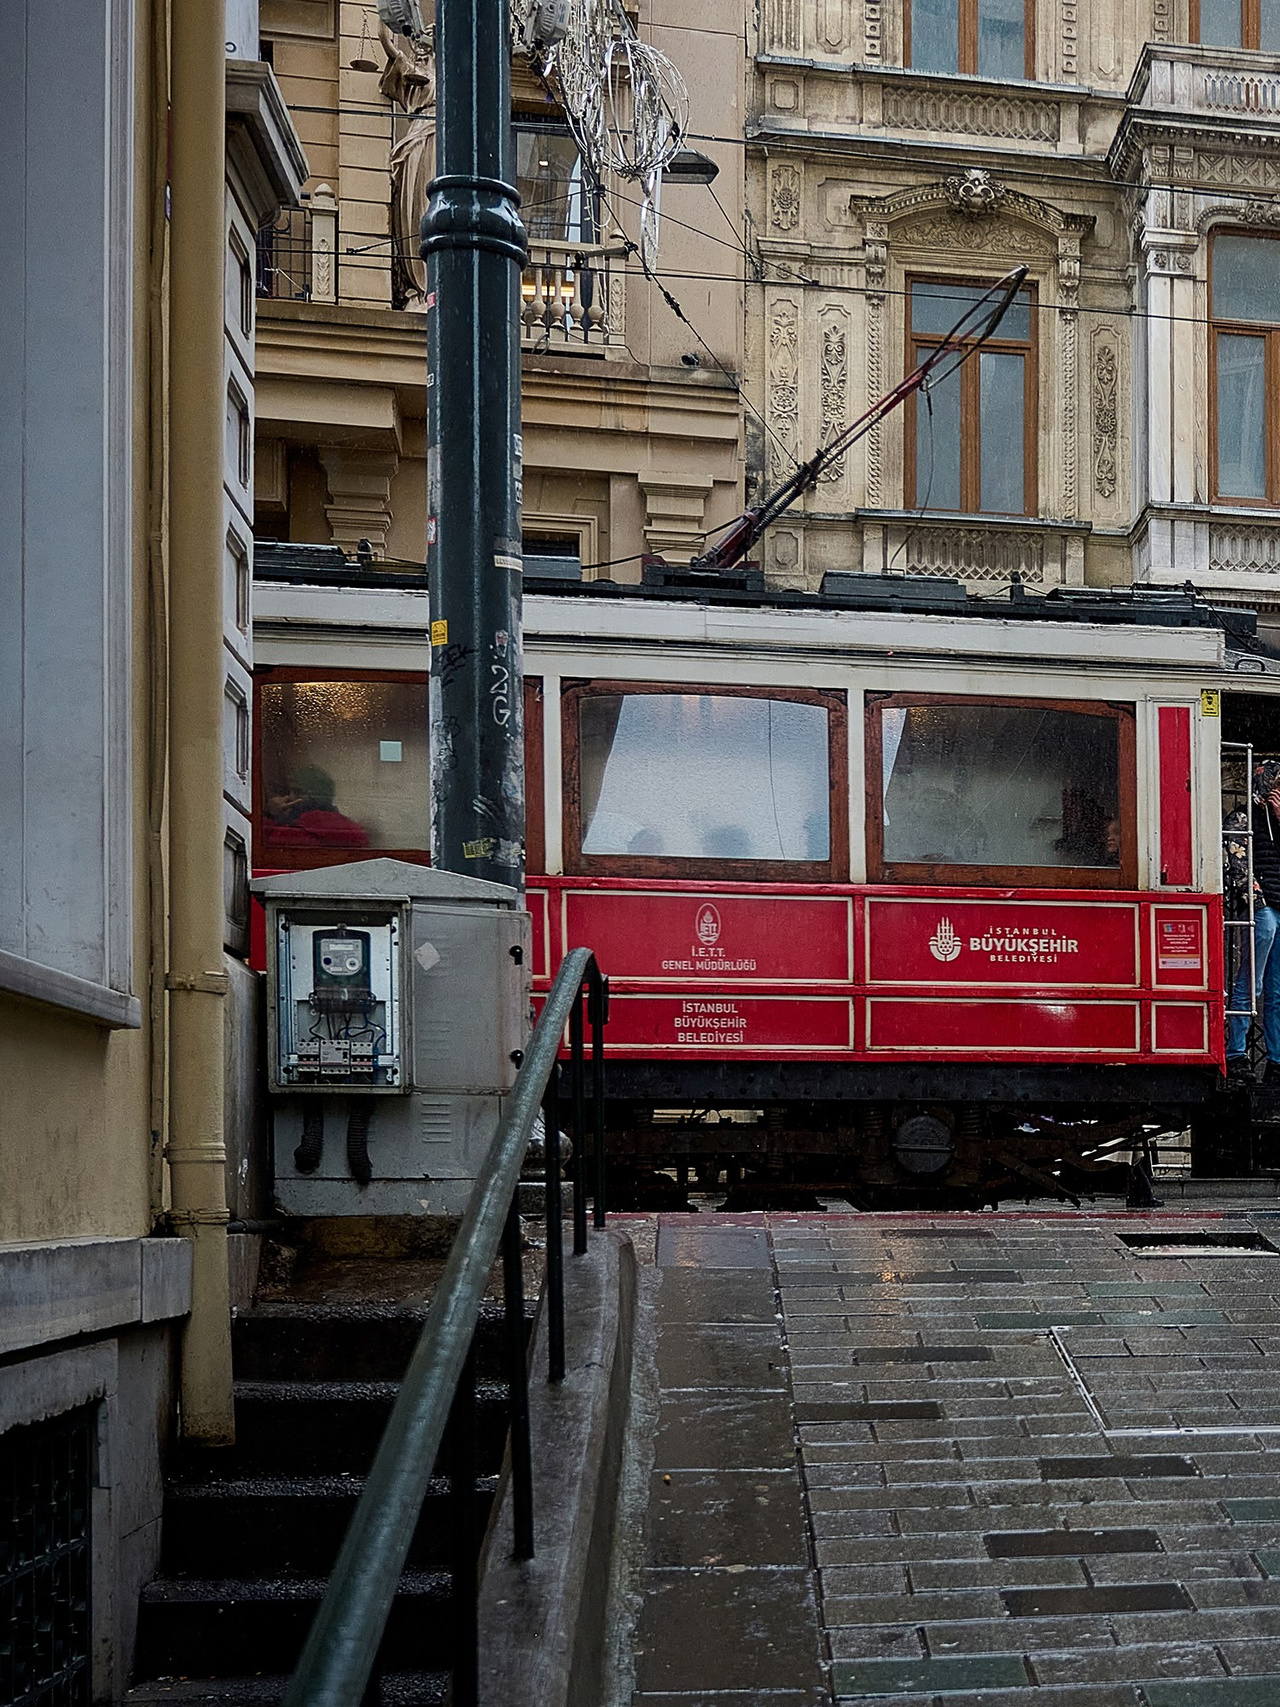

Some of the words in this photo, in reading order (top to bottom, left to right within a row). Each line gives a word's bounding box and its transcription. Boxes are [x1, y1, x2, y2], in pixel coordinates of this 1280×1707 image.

[989, 925, 1058, 936] İSTANBUL
[969, 933, 1079, 956] BÜYÜKŞEHİR
[691, 945, 726, 958] İ.E.T.T.
[661, 960, 695, 971] GENEL
[696, 958, 757, 971] MÜDÜRLÜĞÜ
[681, 1001, 739, 1013] İSTANBUL
[674, 1015, 747, 1030] BÜYÜKŞEHİR
[678, 1031, 744, 1043] BELEDİYESİ
